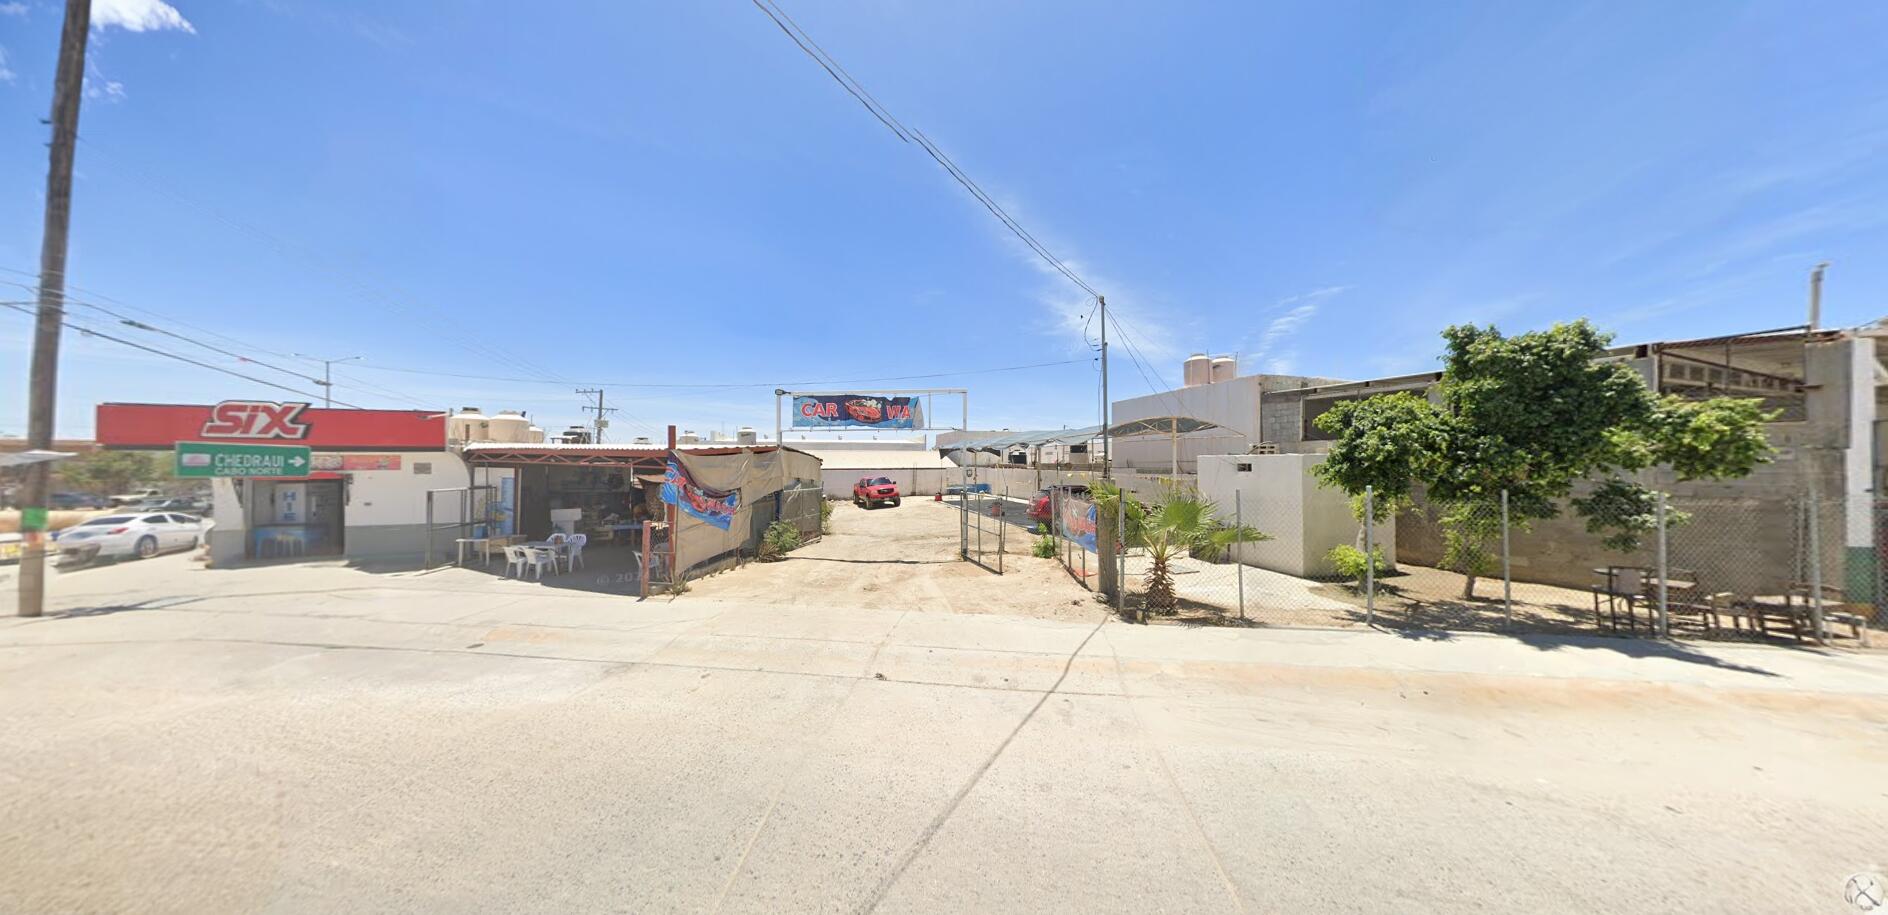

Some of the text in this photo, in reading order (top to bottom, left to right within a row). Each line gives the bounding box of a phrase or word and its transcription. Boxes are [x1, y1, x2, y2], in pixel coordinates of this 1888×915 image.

[801, 402, 839, 417] CAR
[215, 454, 284, 467] CHEDRAUI
[214, 467, 283, 475] CABO NORTE
